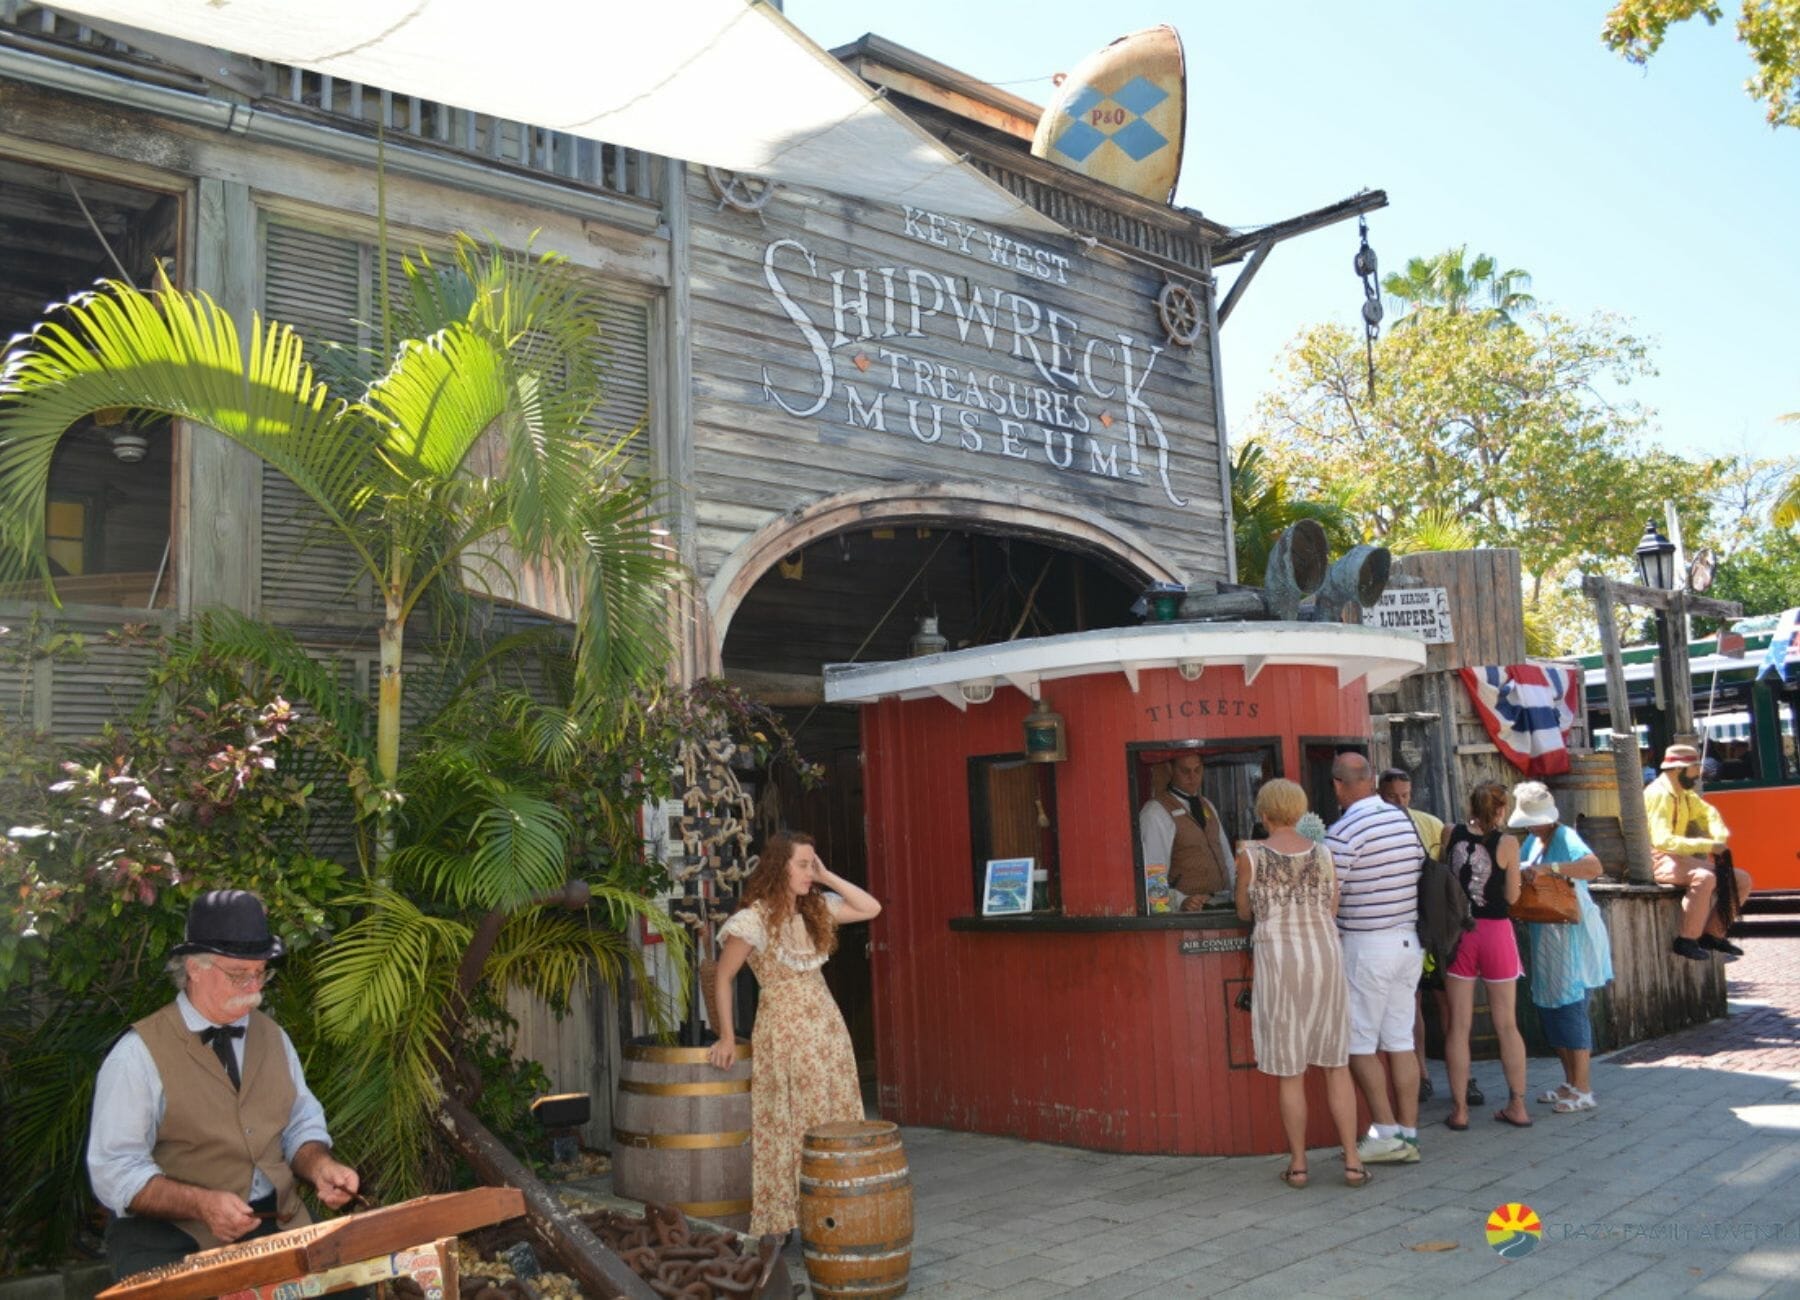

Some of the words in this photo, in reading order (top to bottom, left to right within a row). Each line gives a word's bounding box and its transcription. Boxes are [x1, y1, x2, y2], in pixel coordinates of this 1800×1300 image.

[901, 204, 976, 256] KEY
[983, 231, 1070, 285] WEST
[761, 238, 1189, 508] SHIPWRECK
[879, 348, 1091, 434] TREASURES
[842, 385, 1122, 478] MUSEUM
[1380, 609, 1435, 627] LUMPERS
[1145, 699, 1259, 722] TICKETS
[1183, 941, 1199, 949] AIR
